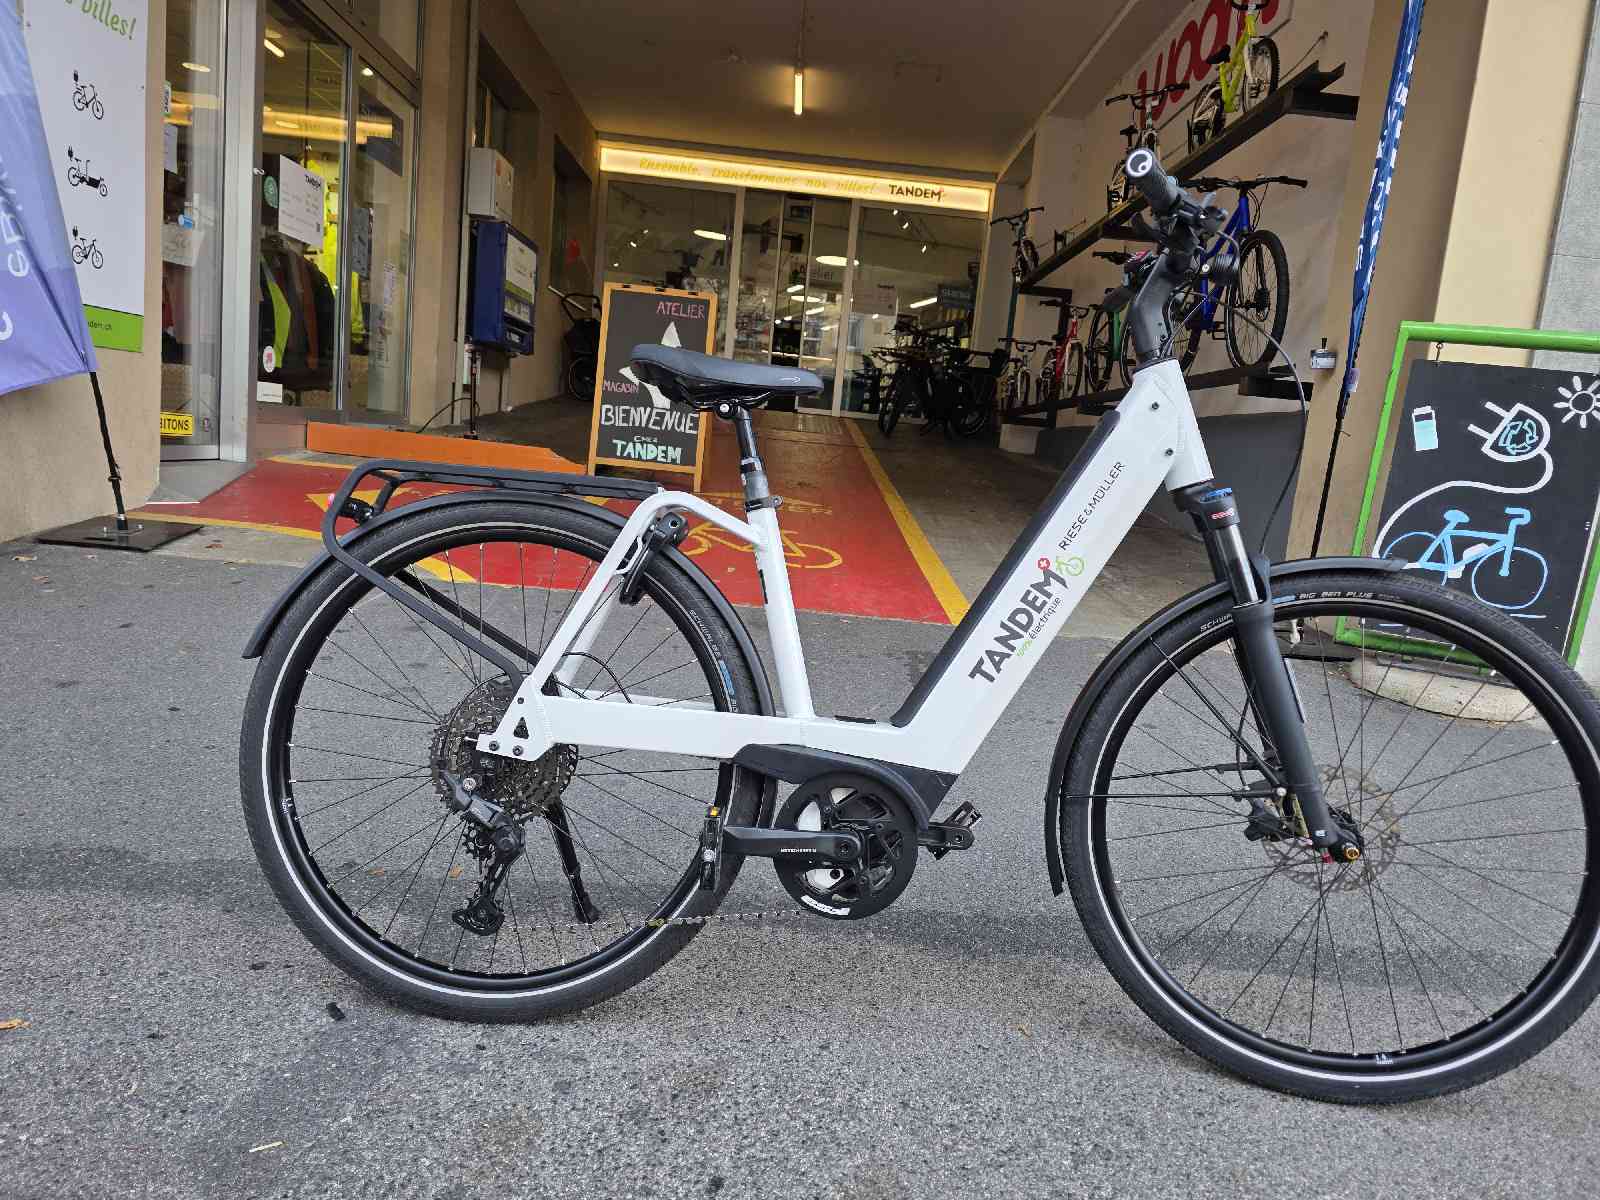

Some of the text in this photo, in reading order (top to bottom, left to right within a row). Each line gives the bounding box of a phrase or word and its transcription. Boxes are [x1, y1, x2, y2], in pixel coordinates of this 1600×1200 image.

[888, 184, 943, 202] TANDEM
[656, 301, 705, 319] ATELIER
[603, 380, 640, 393] MAGASIN
[601, 404, 700, 434] BIENVENUE
[612, 439, 682, 464] TANDEM
[968, 565, 1069, 684] TANDEM
[1028, 596, 1062, 640] électrique
